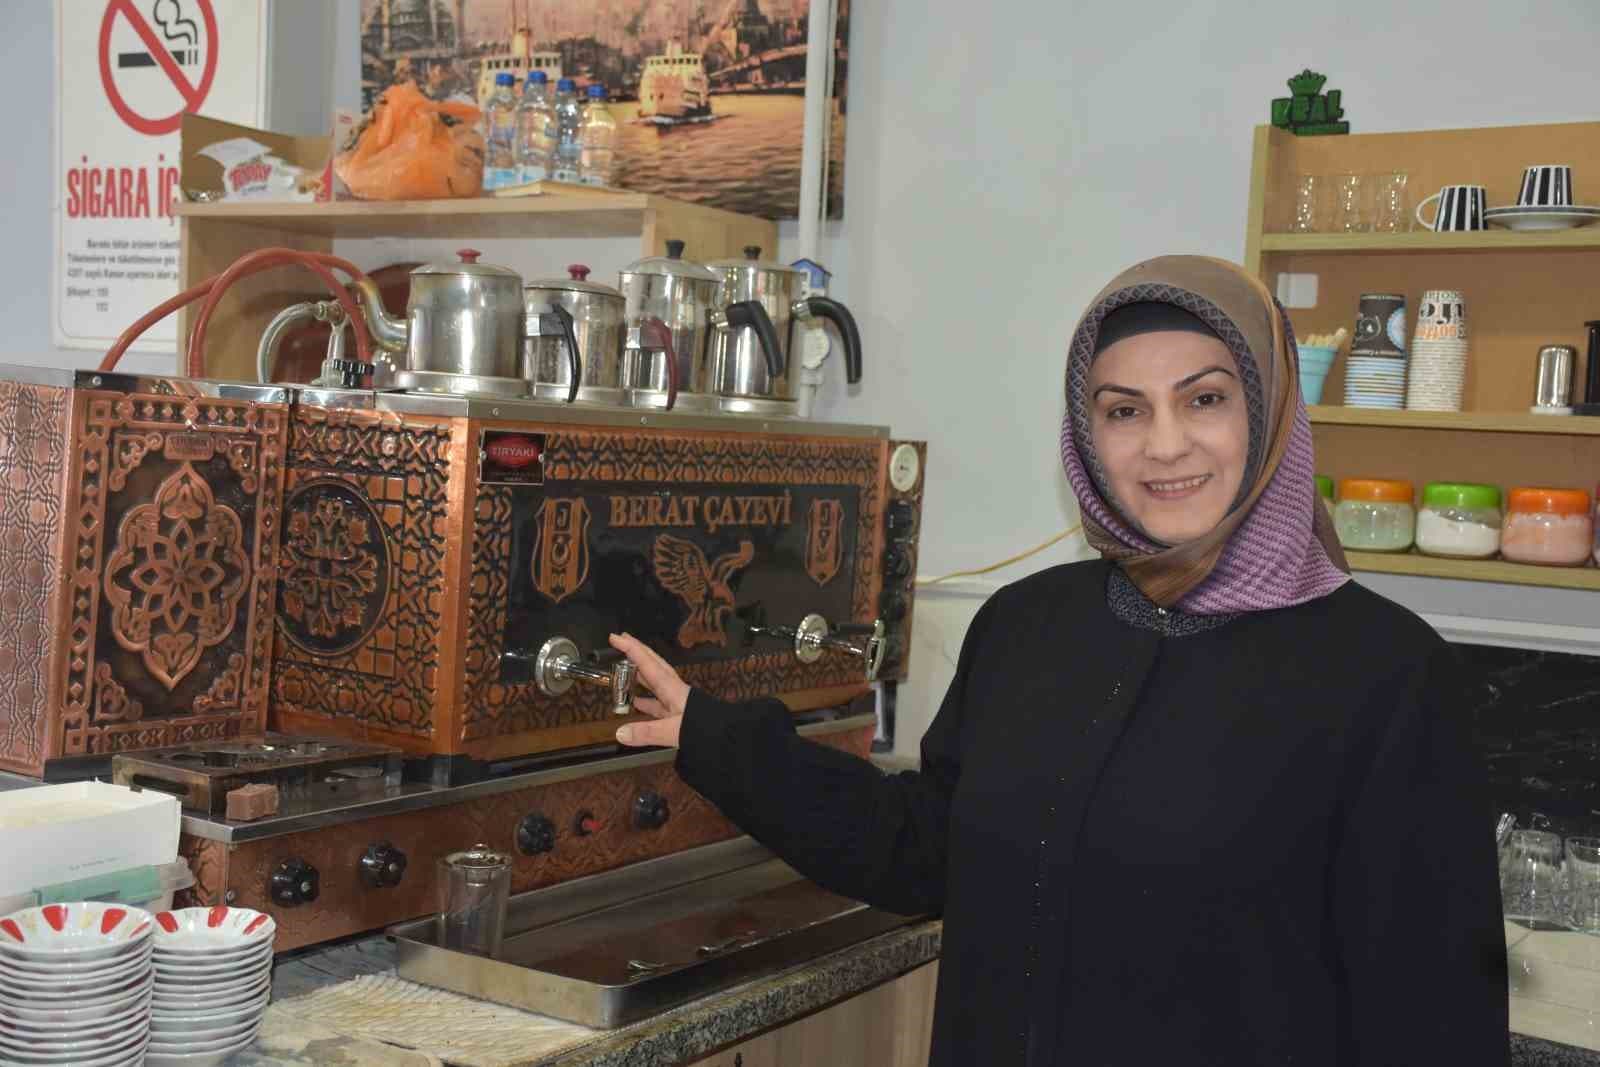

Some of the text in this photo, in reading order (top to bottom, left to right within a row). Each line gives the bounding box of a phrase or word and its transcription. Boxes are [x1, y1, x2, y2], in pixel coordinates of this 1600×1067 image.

[67, 154, 150, 218] SİGARA
[608, 488, 792, 533] BERAT ÇAYEVİ
